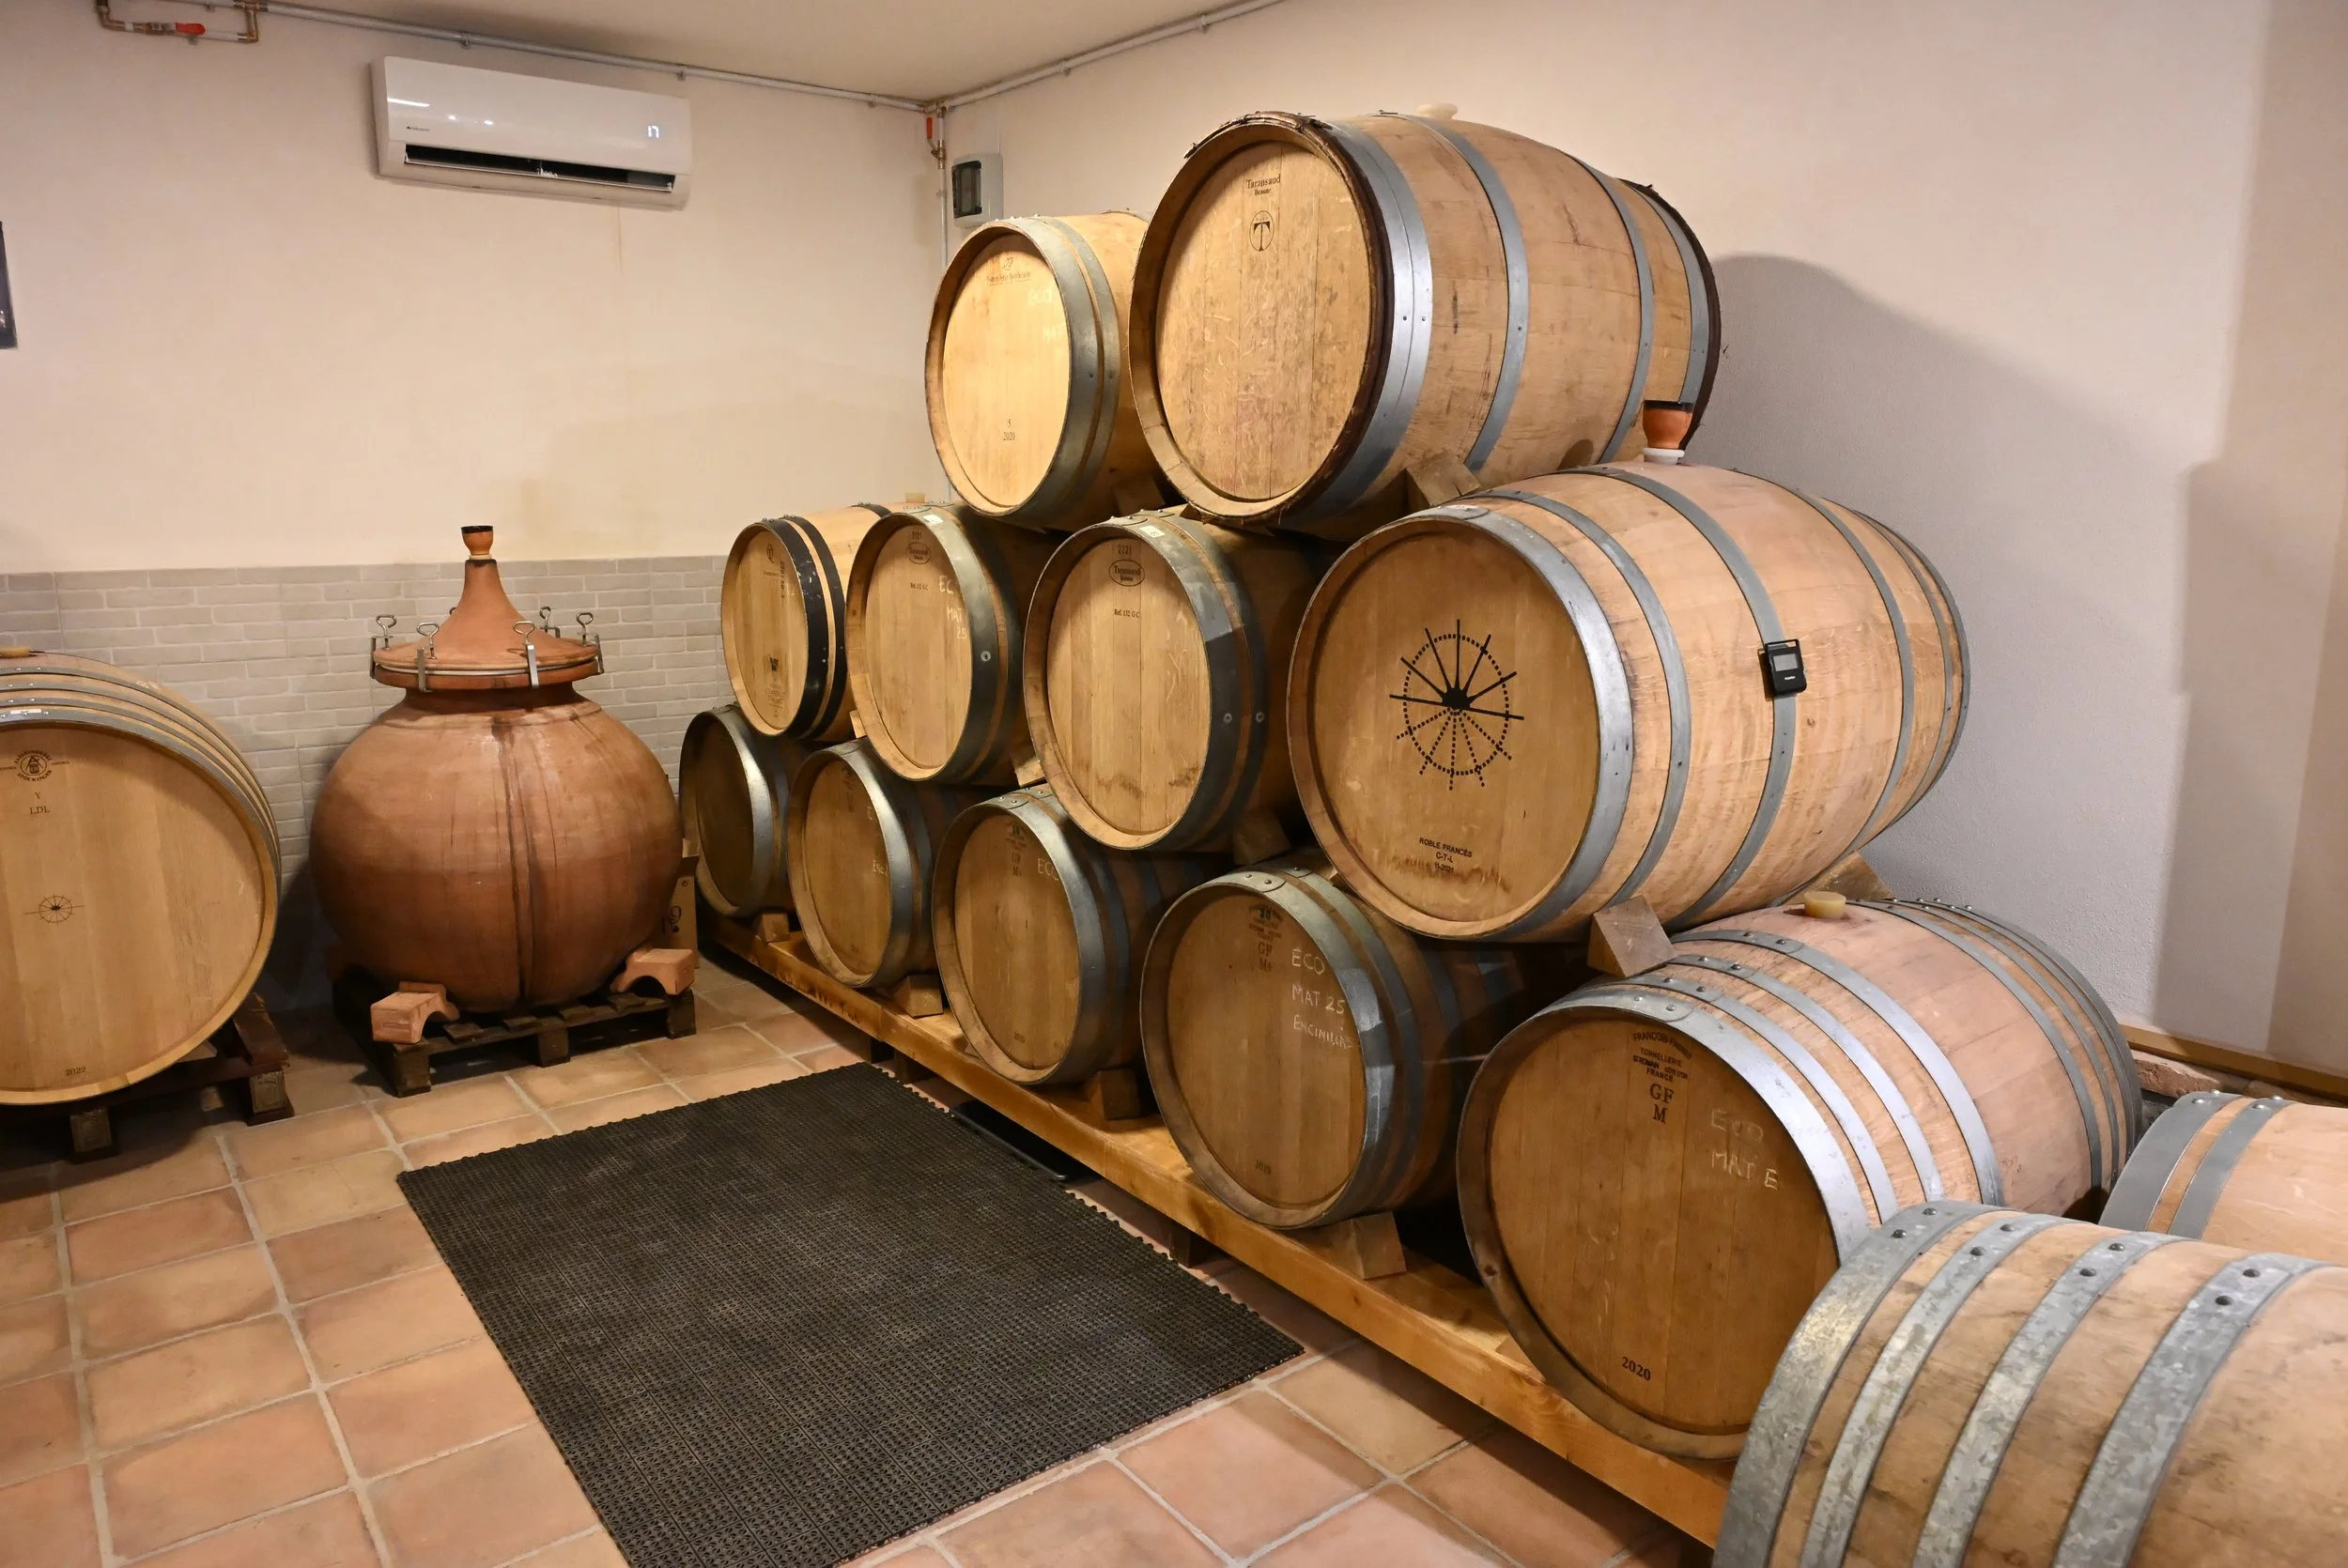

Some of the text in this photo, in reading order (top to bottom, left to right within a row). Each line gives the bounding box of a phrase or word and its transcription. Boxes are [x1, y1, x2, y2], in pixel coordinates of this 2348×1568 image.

[1419, 838, 1441, 849] ROBLE
[1291, 948, 1325, 976] ECO
[1291, 983, 1346, 1015] MAT 25
[1646, 1067, 1674, 1083] FRANCE
[1649, 1083, 1675, 1104] GF
[1652, 1103, 1667, 1124] M
[1621, 1356, 1651, 1381] 2020
